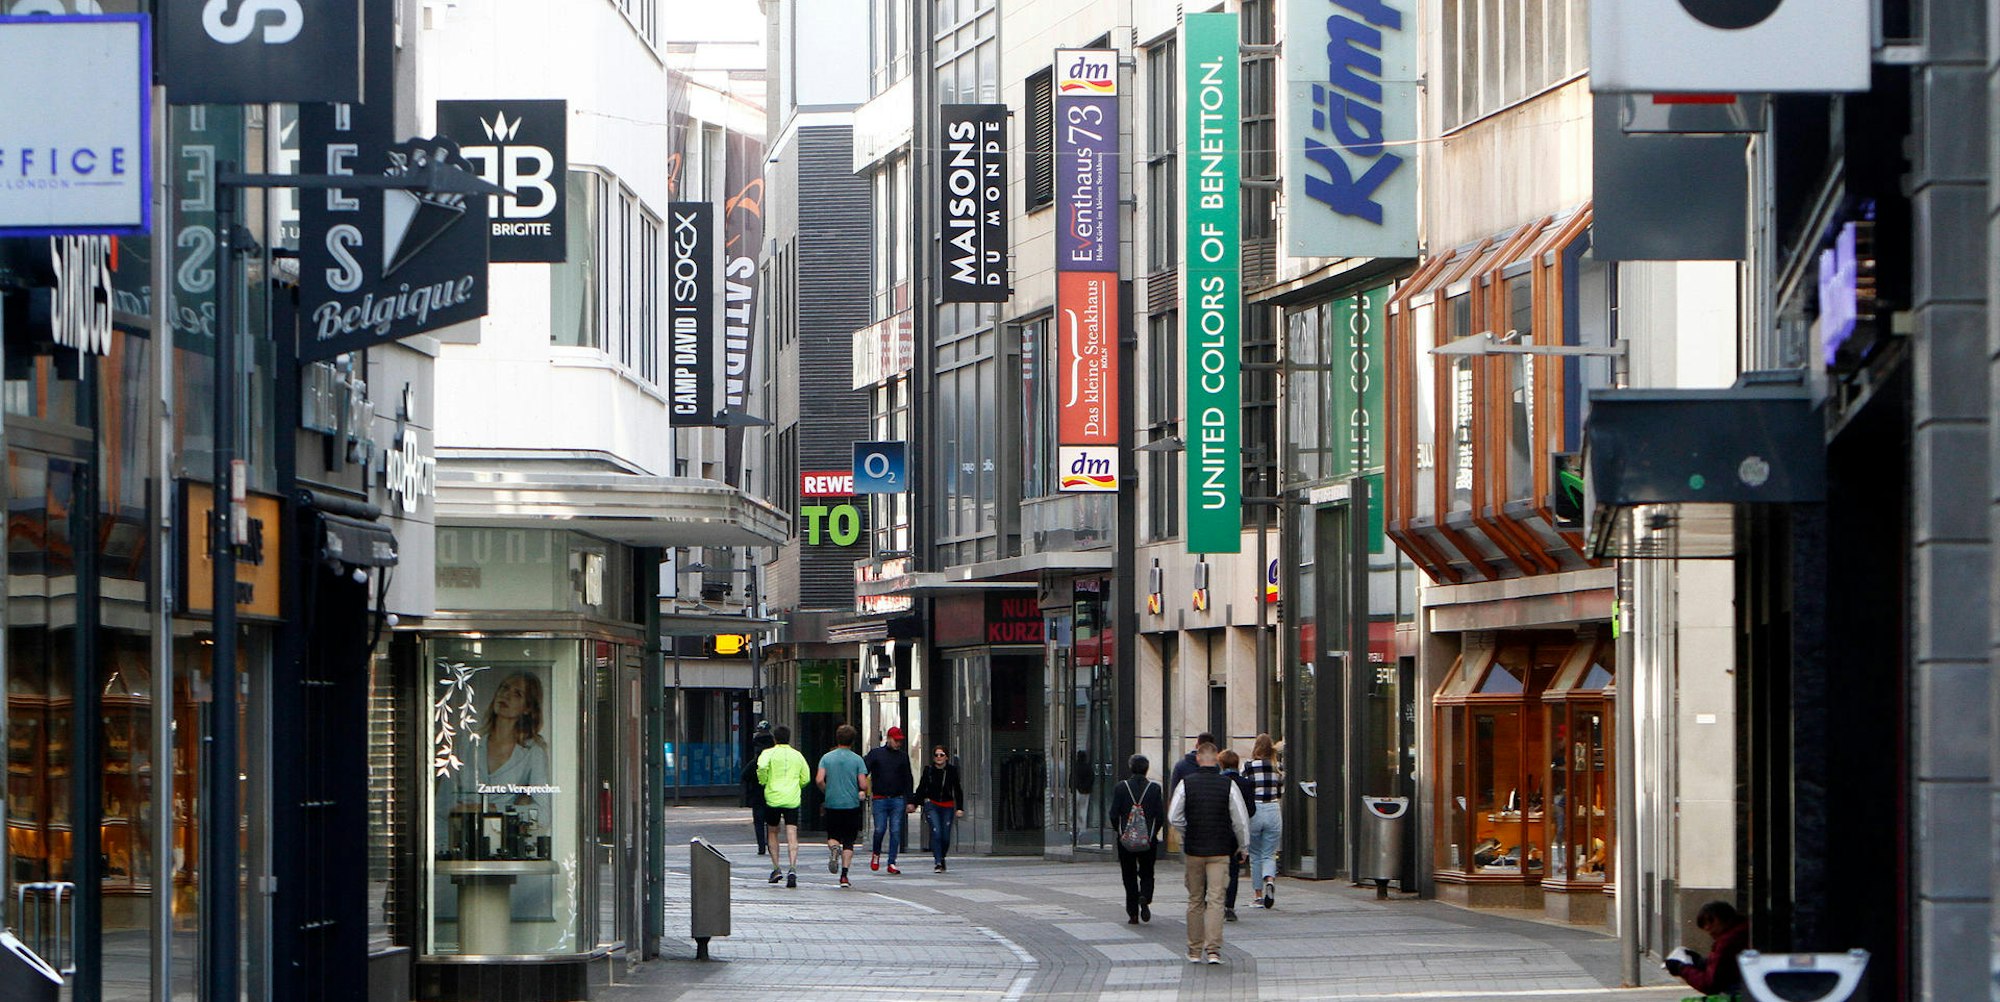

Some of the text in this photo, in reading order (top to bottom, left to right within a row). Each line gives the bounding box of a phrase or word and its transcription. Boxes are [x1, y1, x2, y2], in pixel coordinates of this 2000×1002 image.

[1069, 57, 1108, 79] dm
[6, 180, 69, 190] LONDON
[949, 121, 977, 285] MAISONS
[985, 121, 1001, 286] DU MONDE
[1067, 104, 1103, 262] Eventhaus 73
[492, 223, 552, 236] BRIGITTE
[674, 212, 698, 302] SOCCX
[312, 274, 475, 342] Belgique
[1200, 55, 1225, 510] UNITED COLORS OF BENETTON.
[674, 317, 698, 415] CAMP DAVID
[1084, 279, 1100, 437] Das kleine Steakhaus
[804, 475, 854, 494] REWE
[1071, 452, 1110, 475] dm
[800, 504, 860, 547] TO
[478, 783, 507, 794] Zarte
